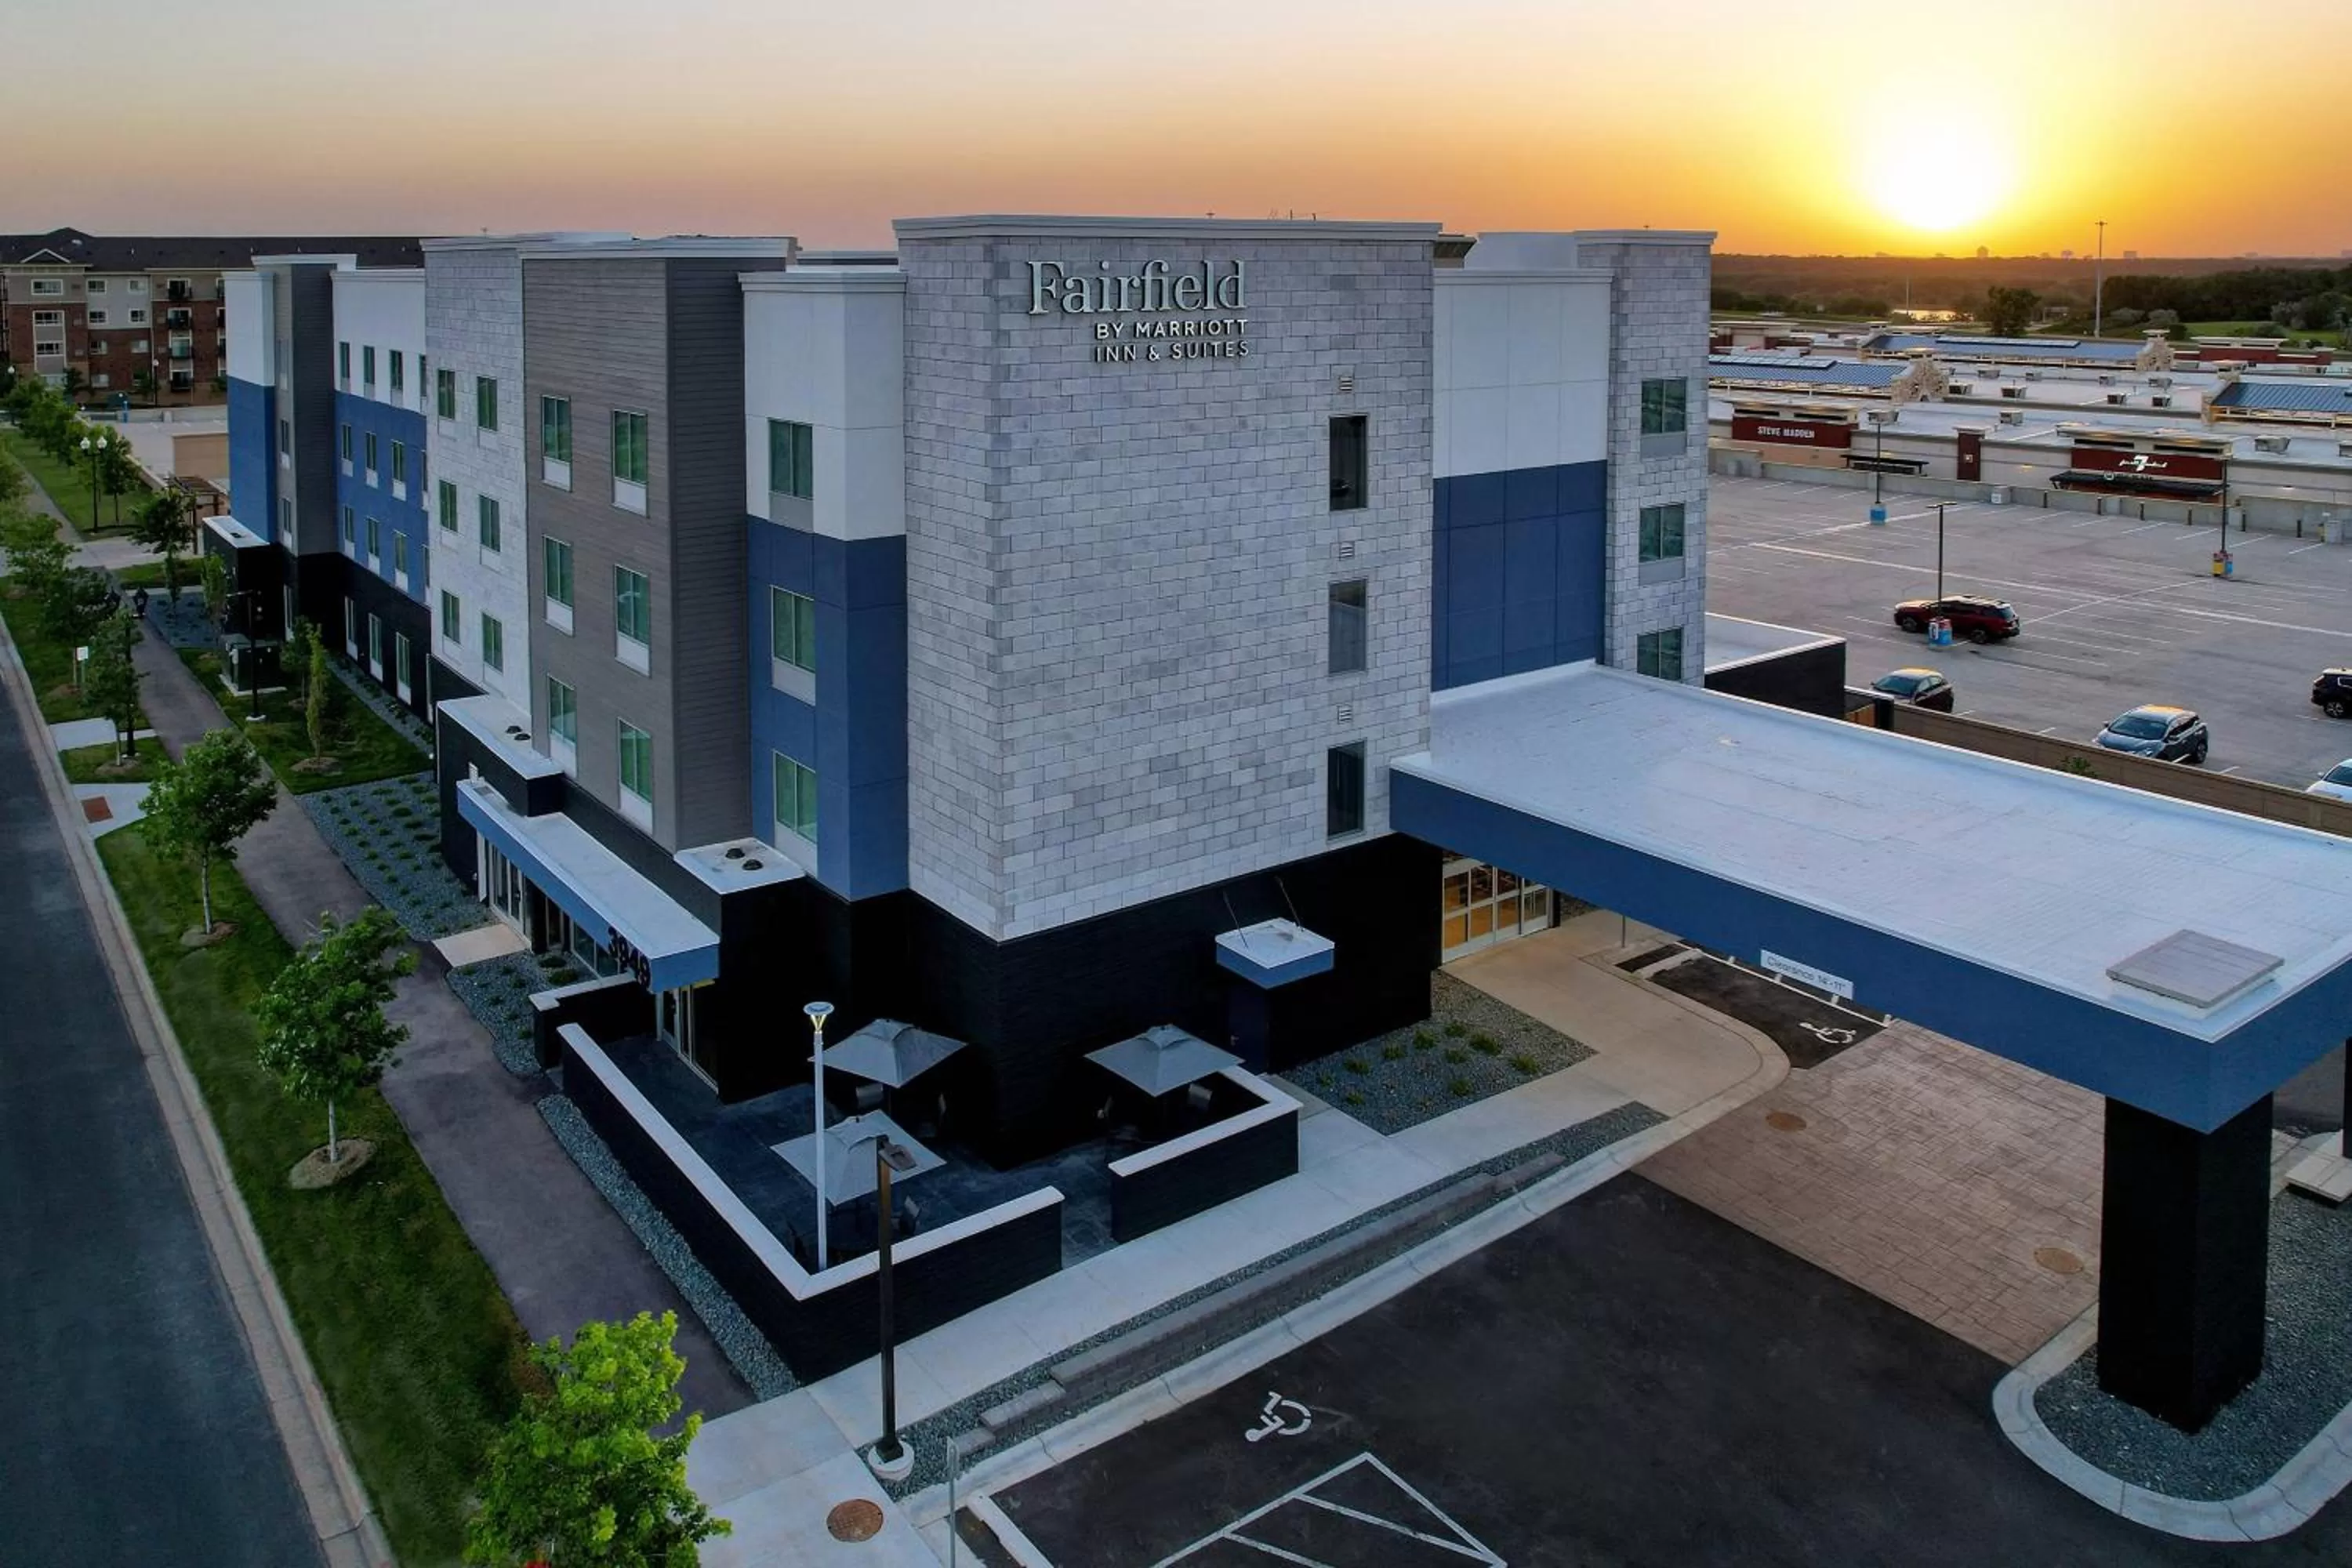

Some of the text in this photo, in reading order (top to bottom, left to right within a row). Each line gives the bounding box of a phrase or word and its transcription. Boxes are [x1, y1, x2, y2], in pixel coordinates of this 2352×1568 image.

[1027, 260, 1247, 314] Fairfield
[1096, 319, 1248, 339] BY MARRIOTT
[1096, 340, 1249, 363] INN & SUITES
[1758, 426, 1815, 438] STEVE MADDEN
[1766, 956, 1815, 981] Clearance
